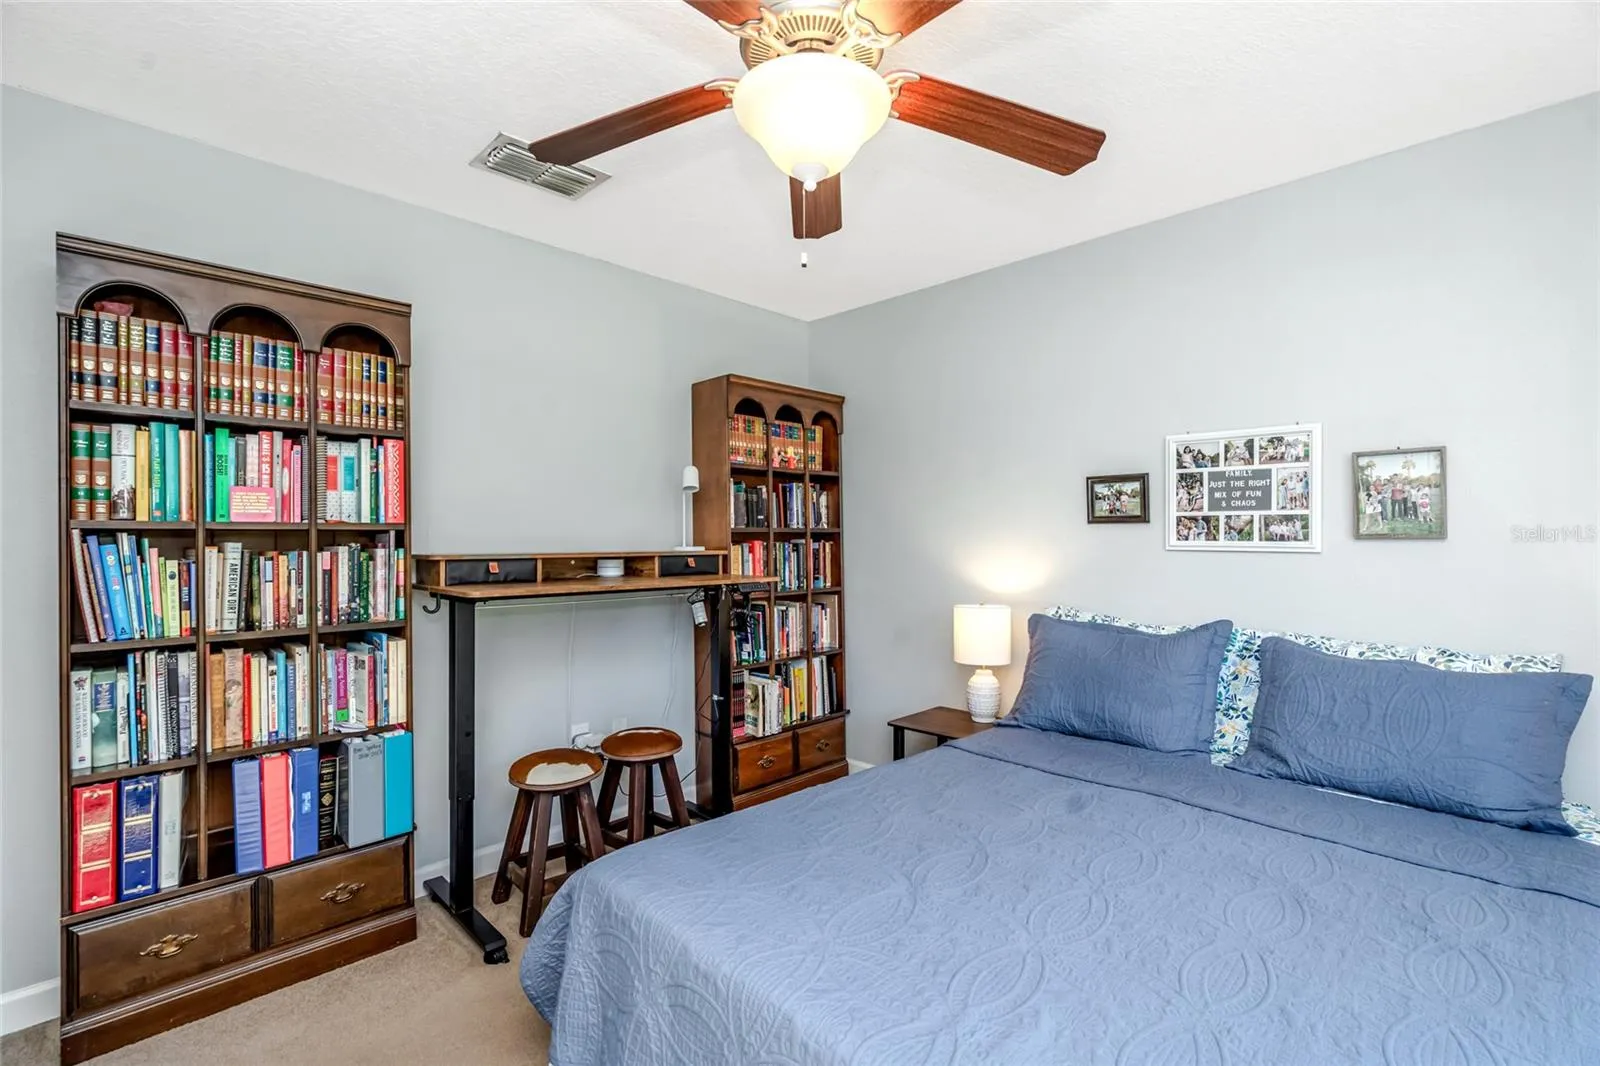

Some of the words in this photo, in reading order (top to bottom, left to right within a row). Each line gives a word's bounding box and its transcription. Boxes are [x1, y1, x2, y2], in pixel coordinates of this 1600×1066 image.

[1209, 480, 1226, 488] JUST
[1248, 479, 1270, 487] RIGHT
[227, 563, 239, 598] AMERICAN
[226, 600, 237, 614] DIRT
